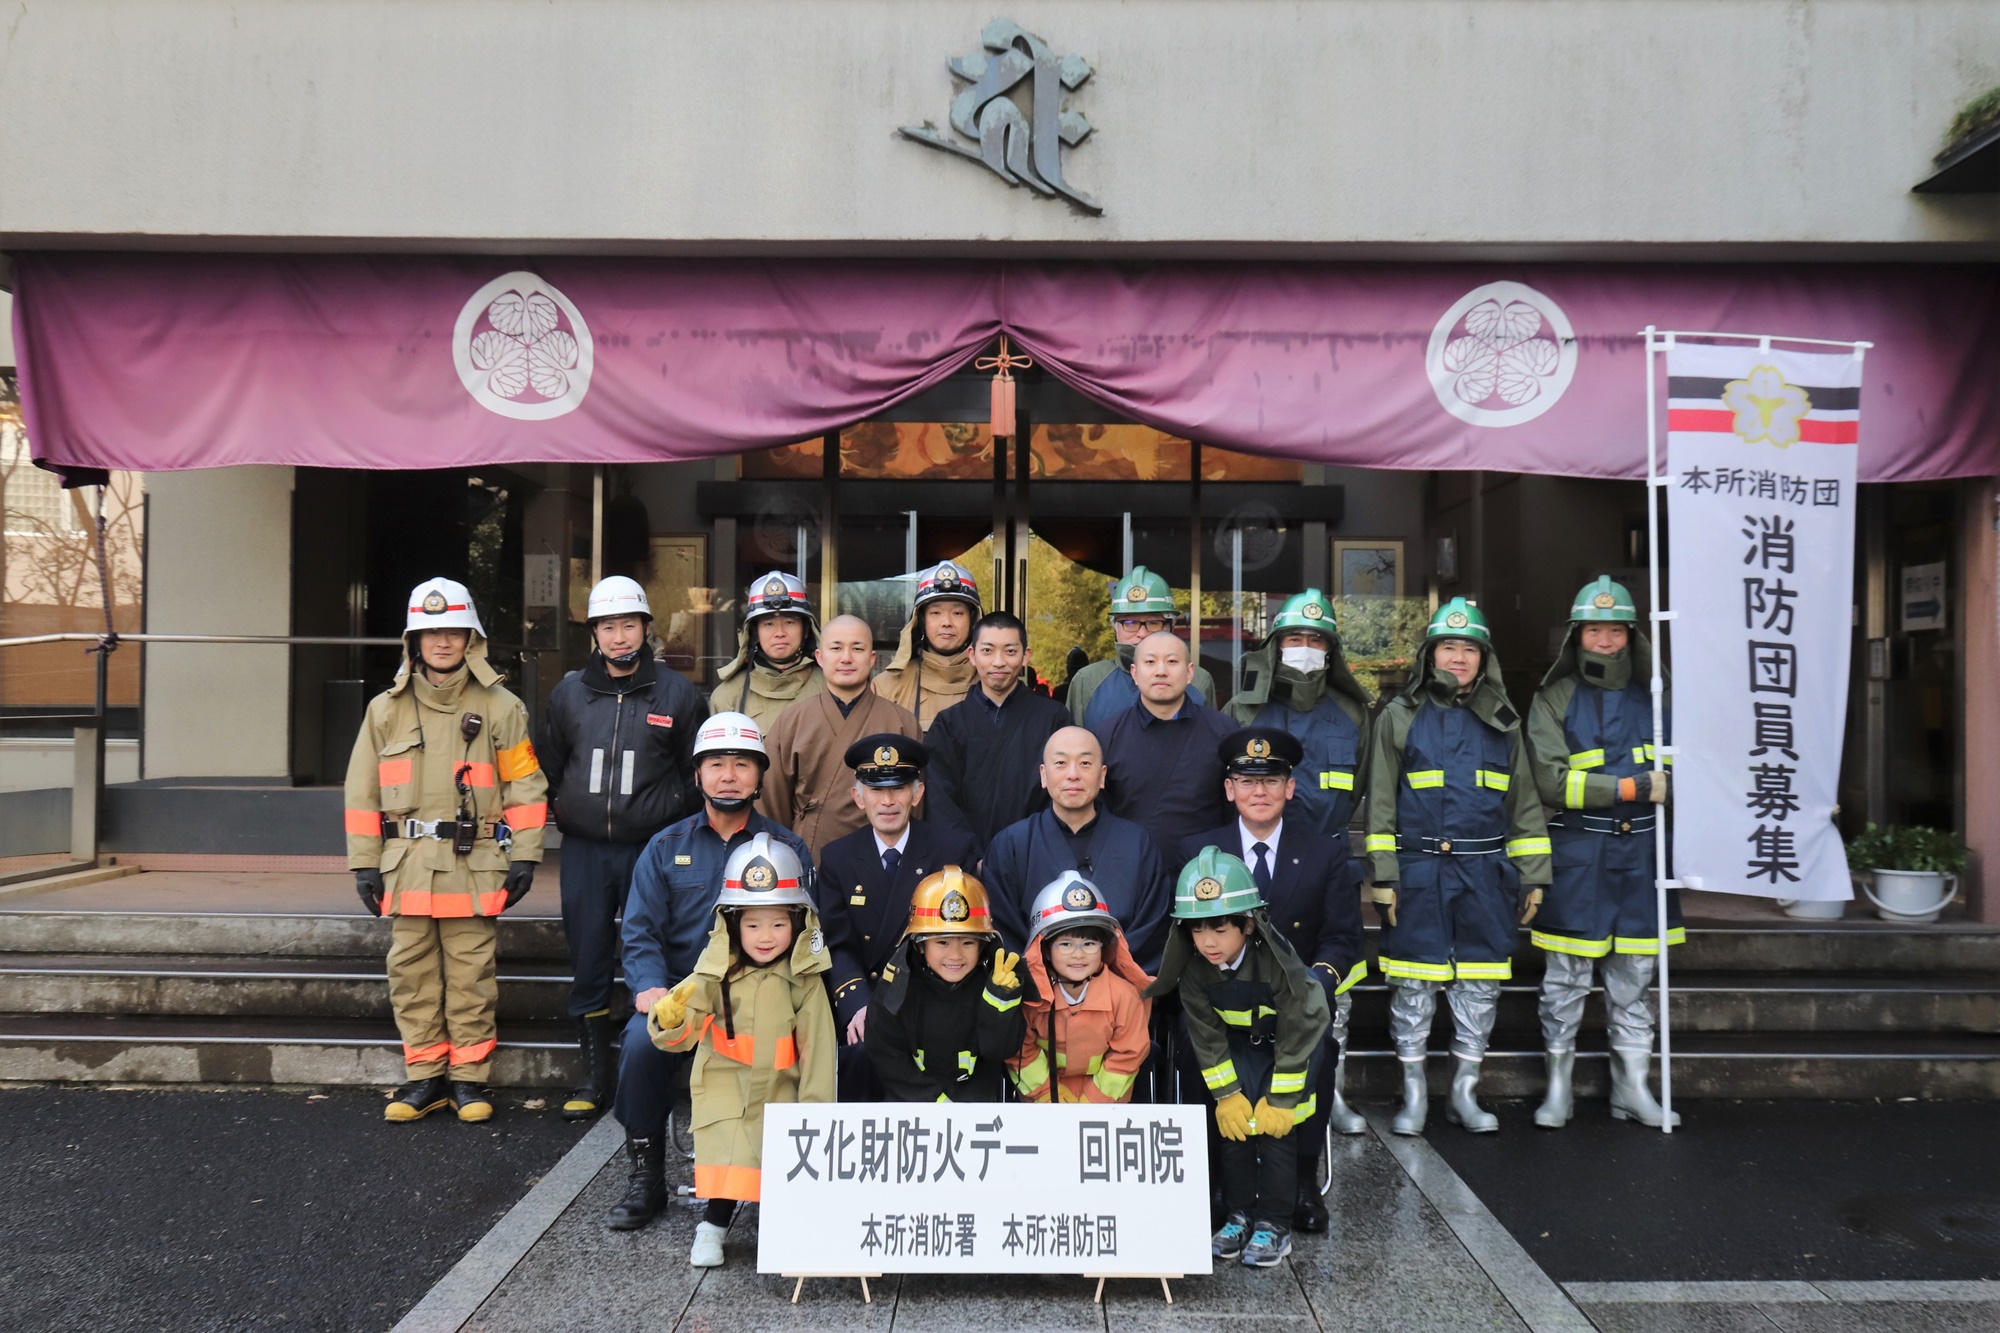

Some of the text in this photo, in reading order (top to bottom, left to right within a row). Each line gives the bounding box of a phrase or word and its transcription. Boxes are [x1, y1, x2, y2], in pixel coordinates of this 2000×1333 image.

[1681, 465, 1840, 508] 本所消防団
[1741, 514, 1802, 884] 消防団員募集
[786, 1115, 1185, 1185] 文化財防火デー 回向院
[859, 1213, 1118, 1258] 本所消防署 本所消防団
